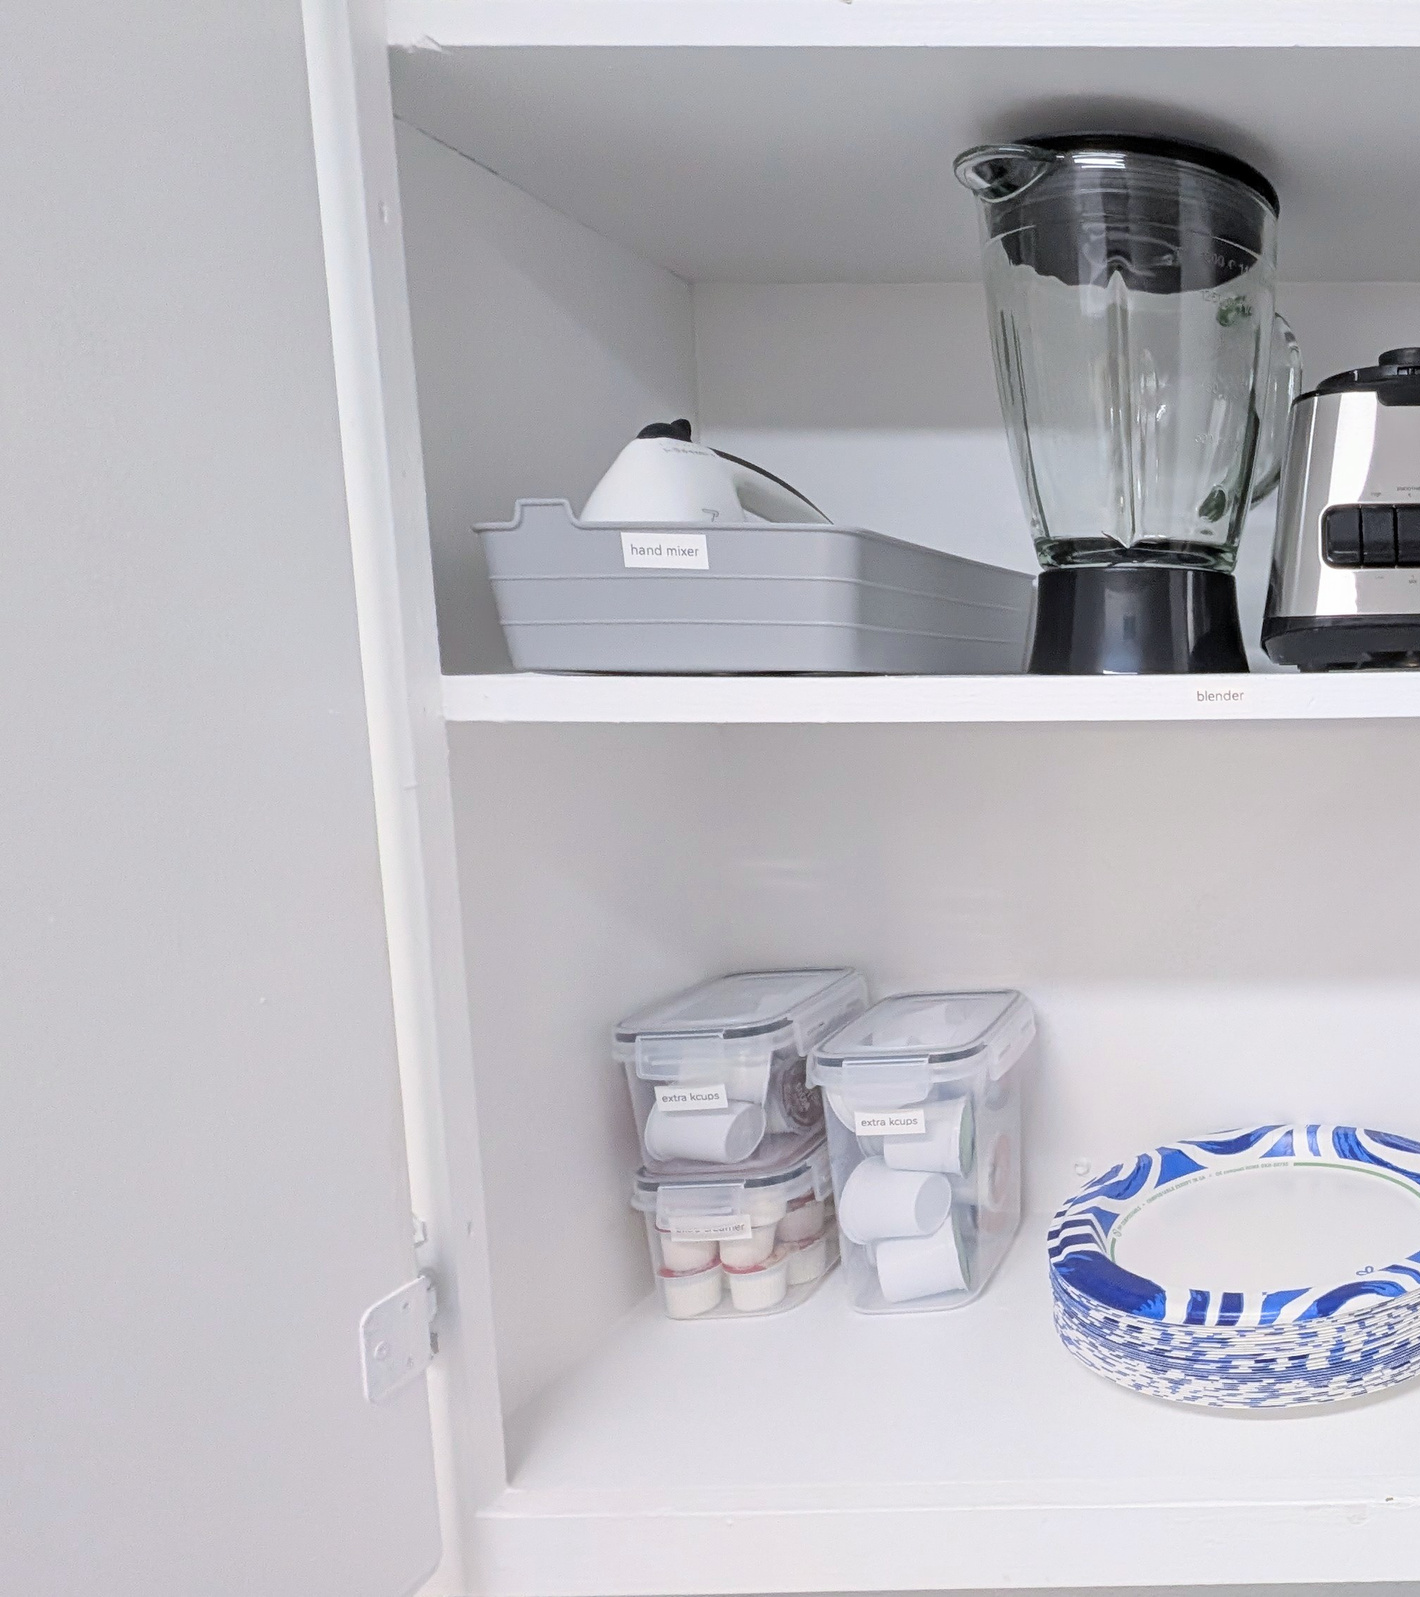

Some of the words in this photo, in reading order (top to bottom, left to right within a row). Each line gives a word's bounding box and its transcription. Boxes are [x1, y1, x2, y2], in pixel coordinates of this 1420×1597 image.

[630, 543, 662, 556] hand
[666, 545, 700, 557] mixer
[1196, 689, 1244, 702] blender
[661, 1094, 687, 1103] extra
[689, 1092, 720, 1102] kcups
[861, 1118, 886, 1127] extra
[888, 1117, 919, 1126] kcups
